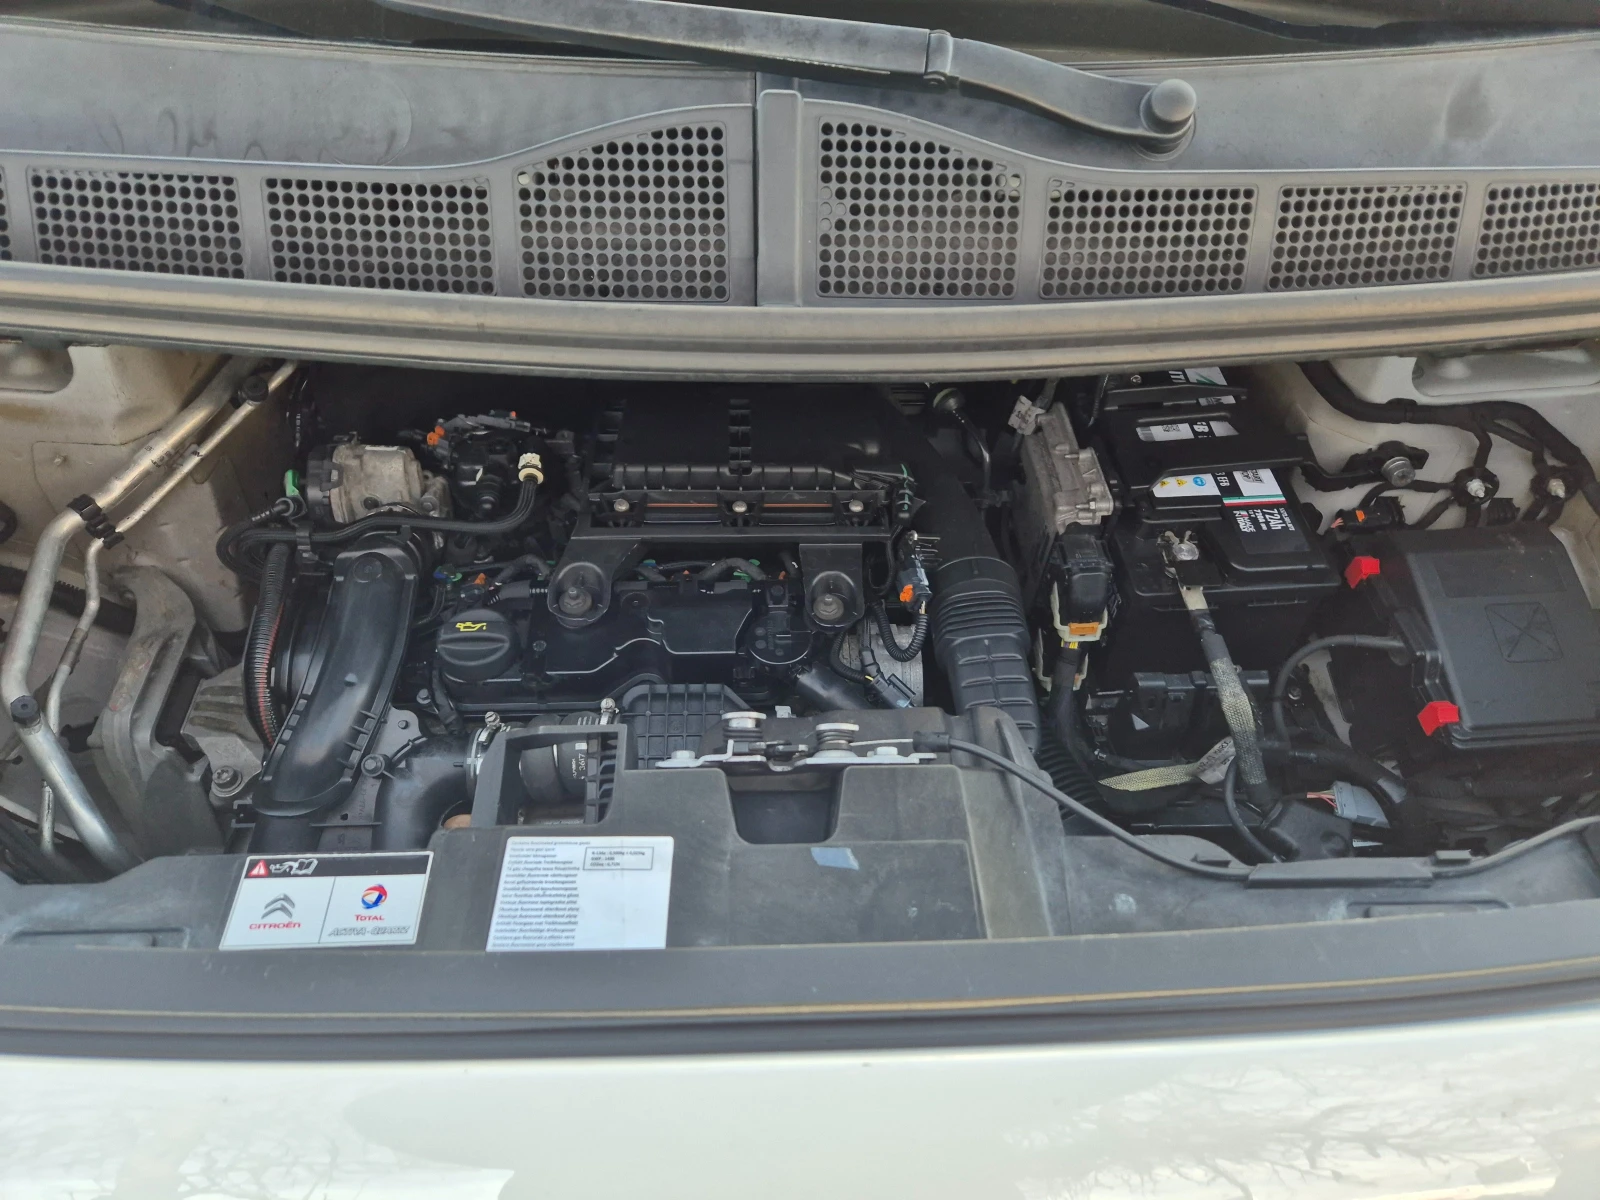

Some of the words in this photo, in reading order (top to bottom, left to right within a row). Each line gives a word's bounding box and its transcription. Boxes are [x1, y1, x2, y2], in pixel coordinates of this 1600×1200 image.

[1217, 476, 1230, 486] EFB
[1236, 517, 1250, 532] ITALY
[1262, 509, 1286, 530] 72Ah
[249, 921, 302, 930] CITROËN
